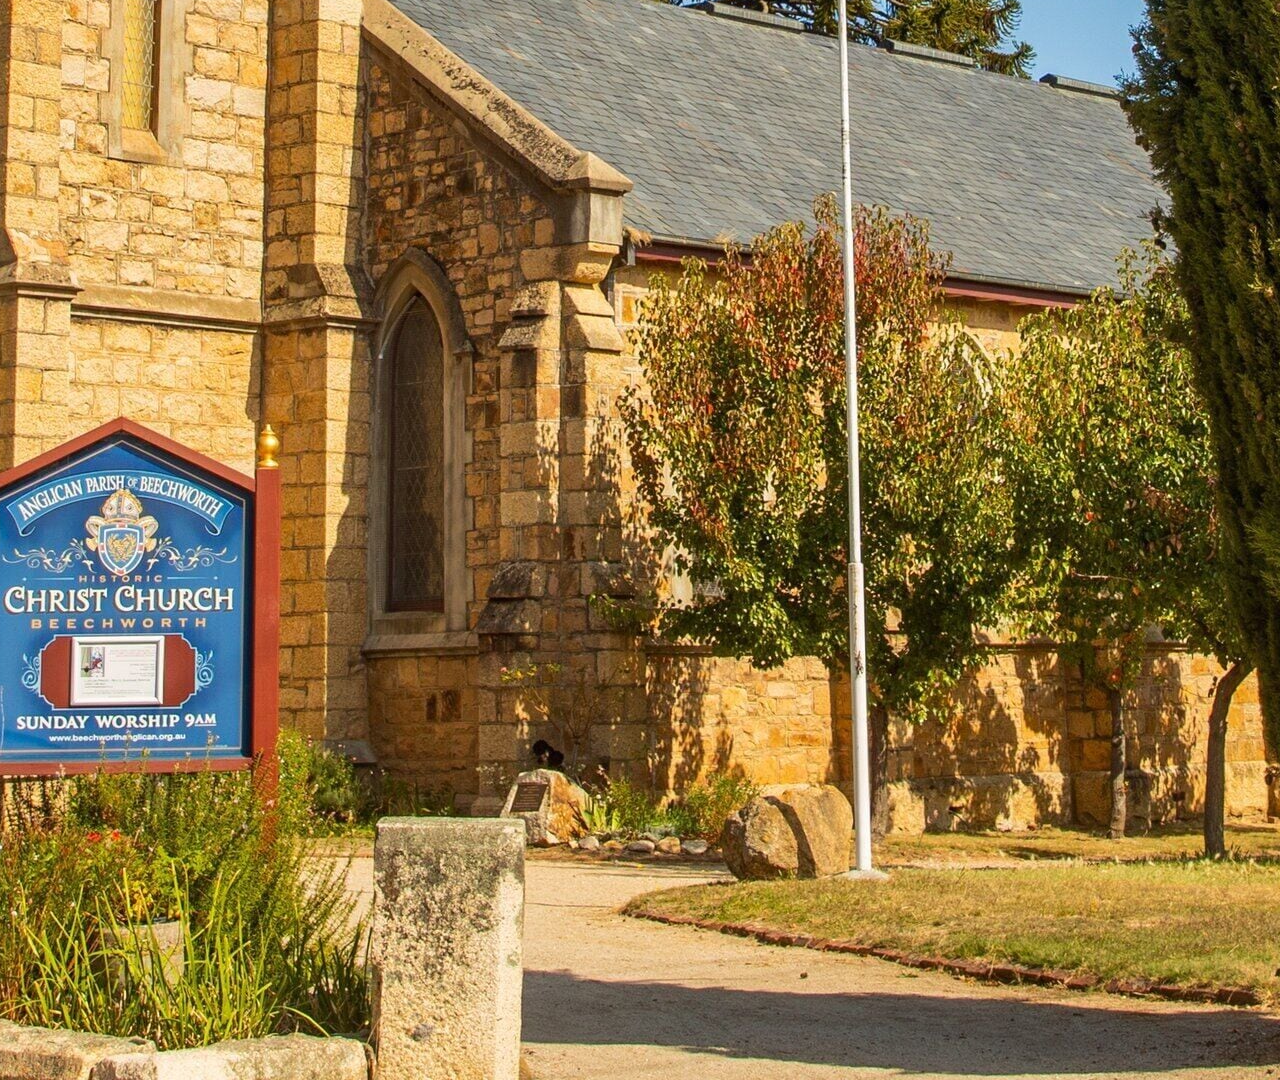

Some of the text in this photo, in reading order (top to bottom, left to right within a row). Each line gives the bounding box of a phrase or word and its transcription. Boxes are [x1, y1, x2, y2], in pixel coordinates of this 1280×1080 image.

[18, 480, 82, 521] ANGLICAN
[85, 475, 125, 493] PARISH
[139, 476, 224, 518] BEECHWORTH
[78, 575, 163, 583] HISTORIC
[4, 584, 234, 613] CHRIST CHURCH
[30, 617, 207, 629] BEECHWORTH
[16, 713, 217, 730] SUNDAY WORSHIP 9AM
